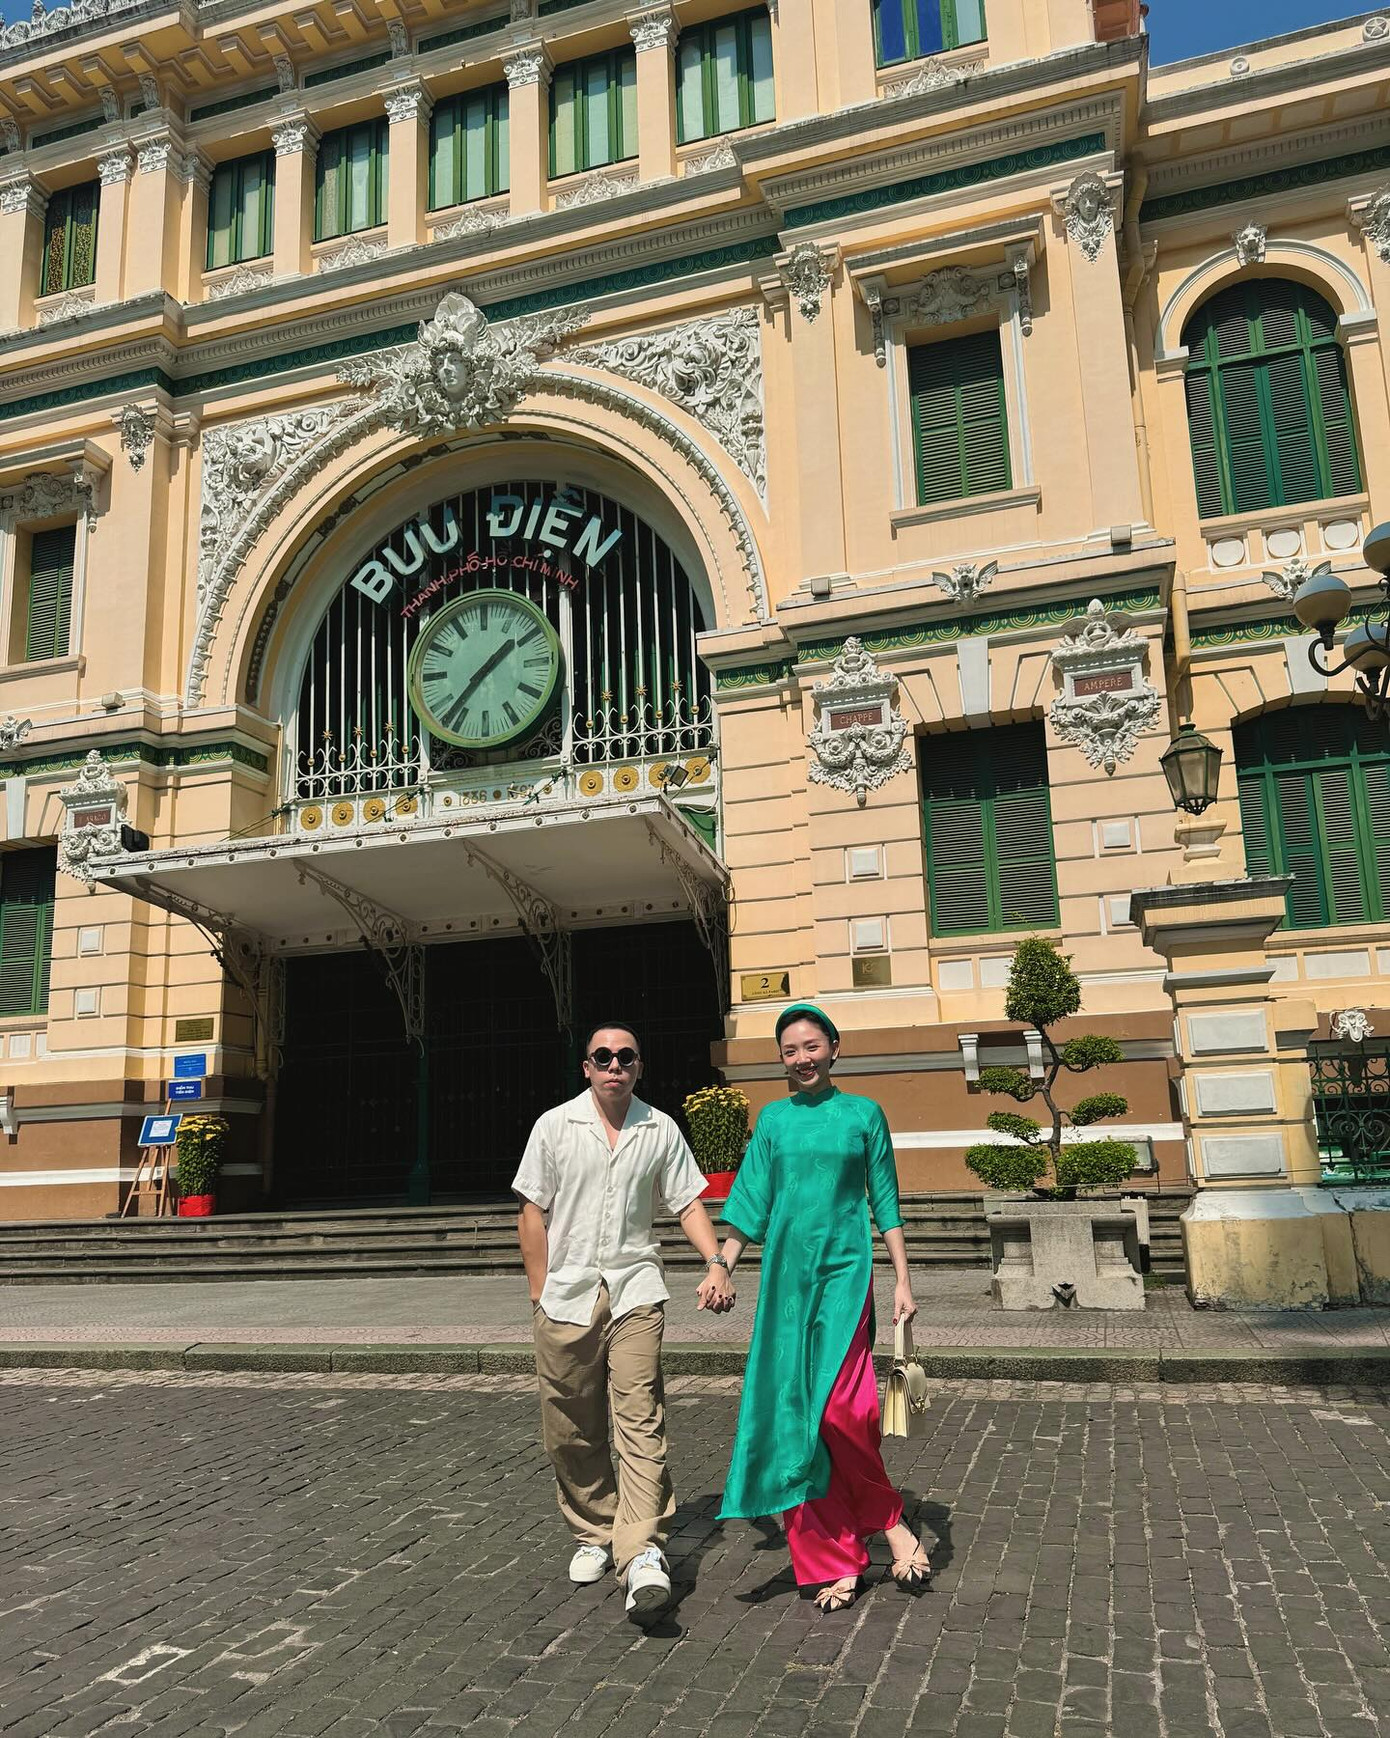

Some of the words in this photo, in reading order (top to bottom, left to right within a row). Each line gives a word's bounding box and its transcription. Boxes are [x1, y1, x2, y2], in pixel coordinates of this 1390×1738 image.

[486, 489, 623, 567] ĐIỆN
[840, 712, 873, 725] CHAPPE
[760, 977, 770, 989] 2
